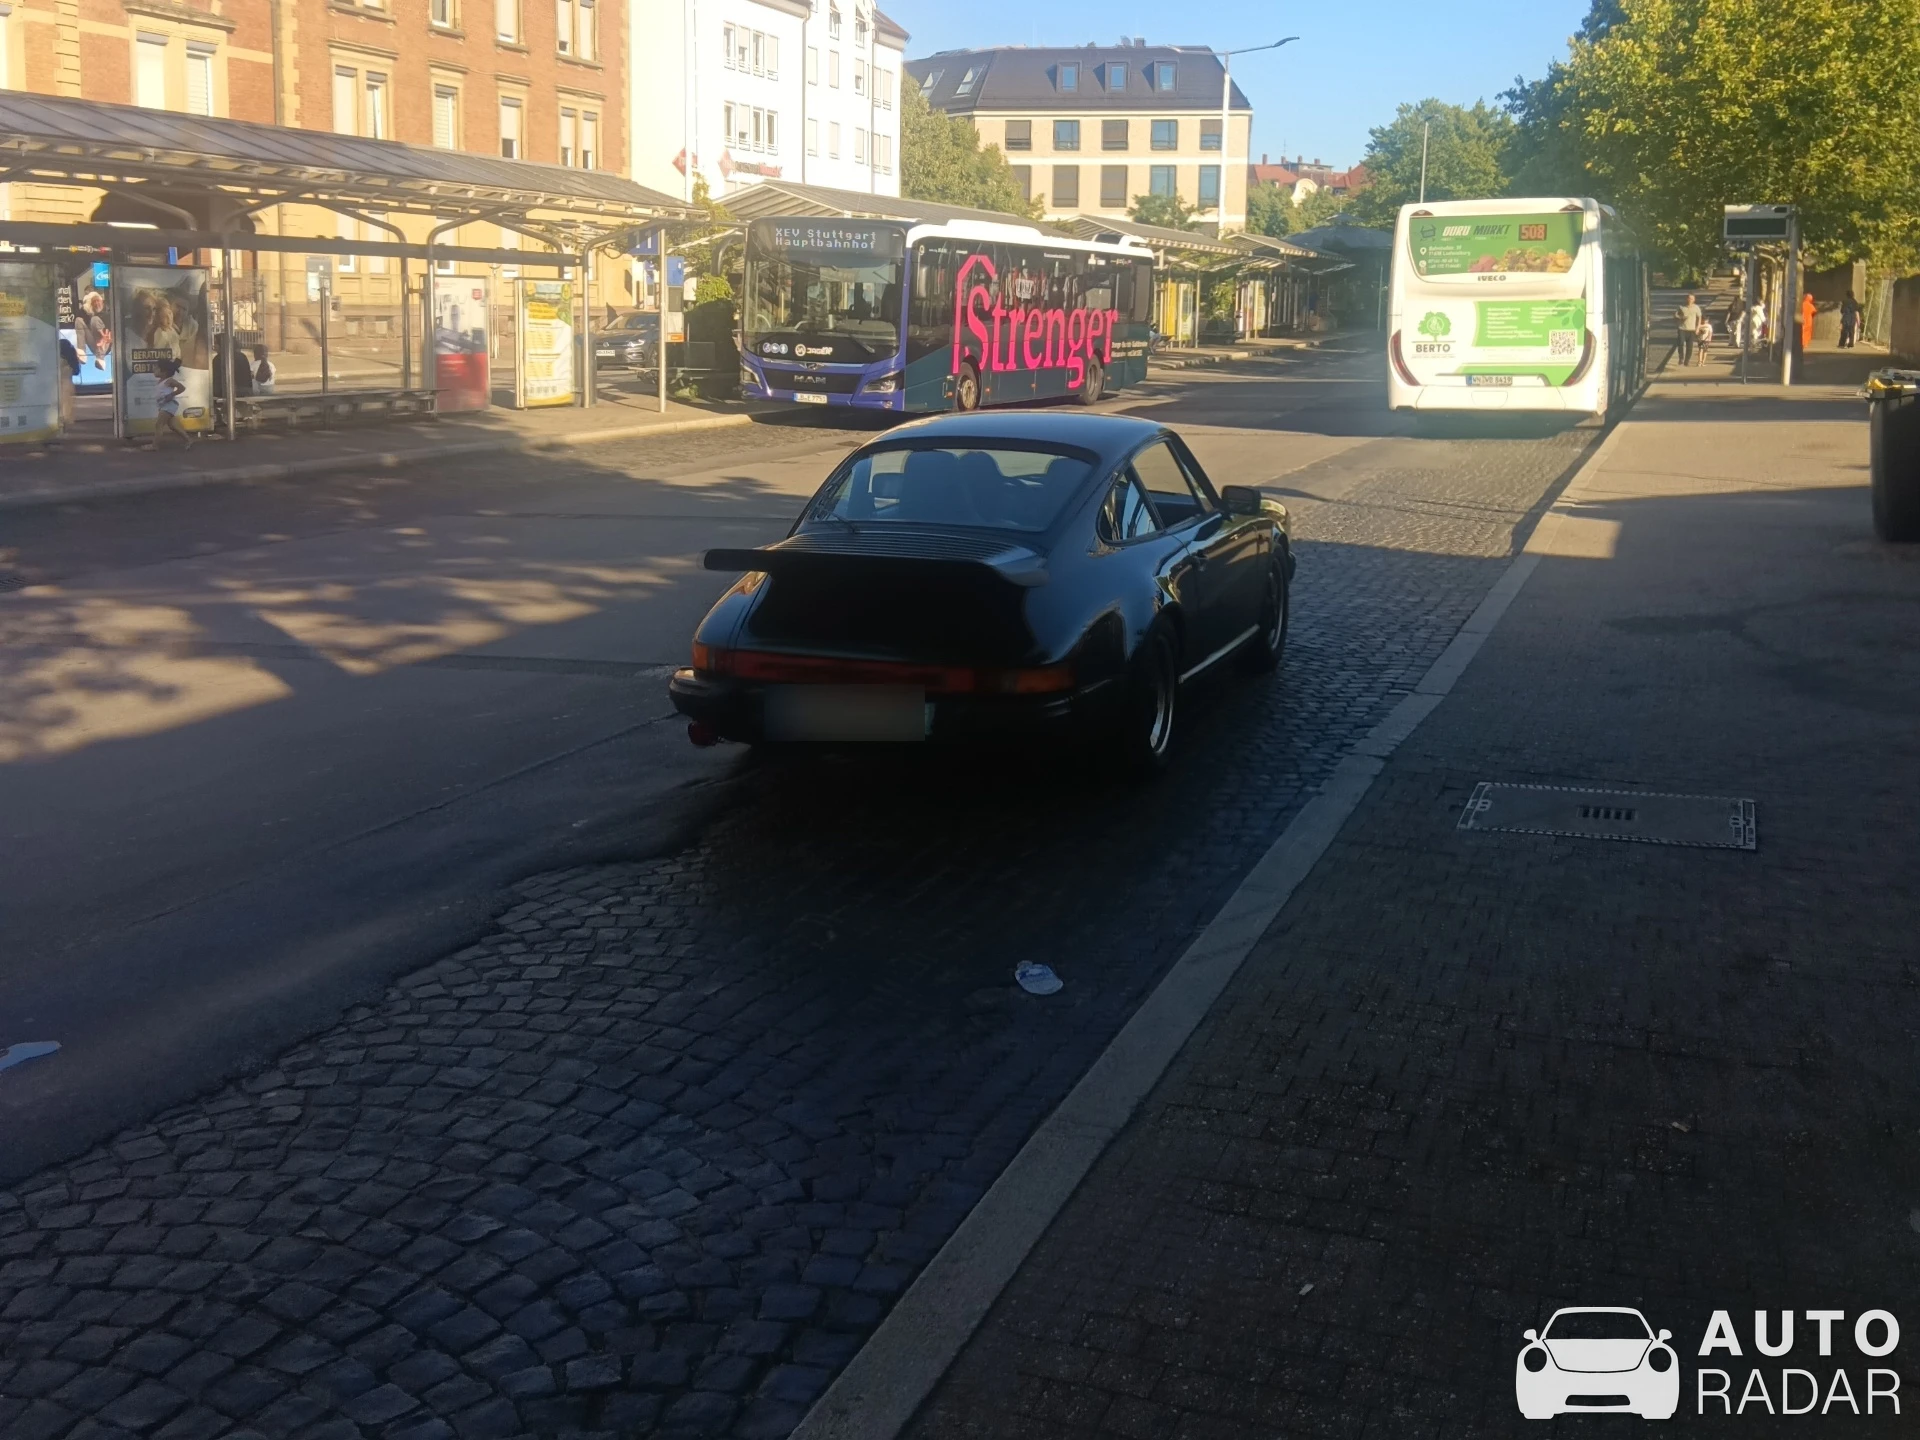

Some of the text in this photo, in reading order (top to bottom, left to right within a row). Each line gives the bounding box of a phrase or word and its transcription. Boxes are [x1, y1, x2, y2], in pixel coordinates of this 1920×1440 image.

[776, 228, 877, 241] XEV Stuttgart
[1521, 224, 1545, 240] 508
[775, 237, 876, 249] Hauptbahnhof
[966, 285, 1118, 389] Strenger
[1416, 344, 1450, 353] BERTO
[133, 350, 171, 360] BERATUNG
[133, 363, 150, 373] GIBT
[794, 374, 826, 385] MAN
